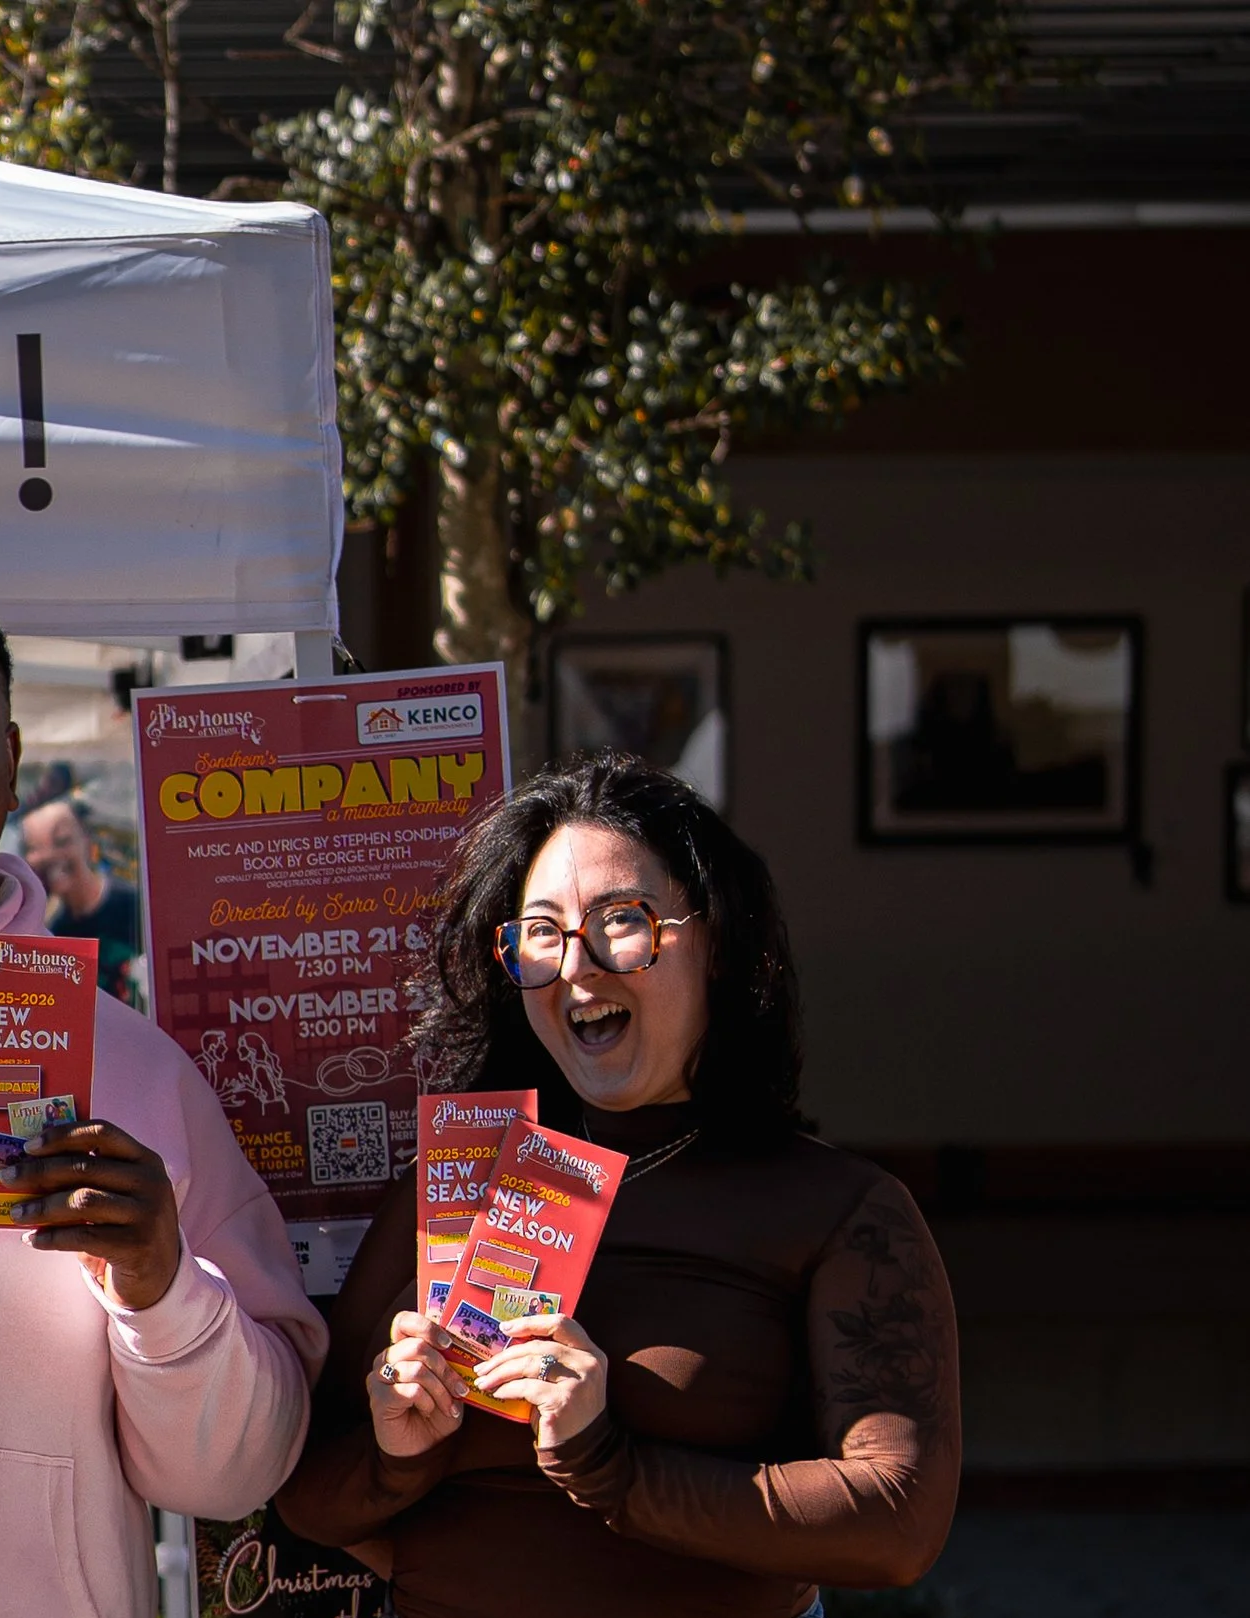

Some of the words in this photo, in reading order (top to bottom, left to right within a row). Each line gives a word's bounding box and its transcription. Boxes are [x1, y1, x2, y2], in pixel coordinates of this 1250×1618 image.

[397, 681, 465, 699] SPONSORED
[468, 680, 482, 690] BY
[156, 703, 177, 716] The
[157, 706, 253, 733] Playhouse
[407, 704, 478, 726] KENCO
[198, 729, 208, 737] of
[209, 725, 238, 736] Wilson
[195, 750, 277, 775] Sondheim's
[159, 751, 486, 822] COMPANY
[327, 808, 340, 823] a
[343, 799, 404, 822] musical
[408, 797, 470, 819] comedy
[188, 843, 231, 860] MUSIC
[235, 841, 265, 856] AND
[268, 837, 310, 854] LYRICS
[314, 836, 330, 850] BY
[332, 832, 392, 849] STEPHEN
[394, 827, 466, 846] SONDHEIM
[243, 856, 284, 872] BOOK
[287, 854, 302, 869] BY
[307, 850, 364, 868] GEORGE
[368, 847, 412, 862] FURTH
[215, 873, 251, 886] ORIGINALLY
[253, 871, 288, 883] PRODUCED
[289, 871, 302, 880] AND
[303, 867, 334, 879] DIRECTED
[336, 866, 346, 875] ON
[347, 863, 381, 875] BROADWAY
[382, 863, 391, 872] BY
[391, 860, 418, 872] HAROLD
[266, 877, 322, 890] ORCHESTRATIONS
[323, 876, 332, 886] BY
[332, 873, 367, 886] JONATHAN
[209, 896, 292, 926] Directed
[294, 896, 318, 924] by
[323, 891, 378, 921] Sara
[191, 928, 361, 966] NOVEMBER
[368, 926, 398, 952] 21
[404, 923, 428, 950] &
[38, 965, 63, 975] Wilson
[294, 958, 338, 979] 7:30
[342, 956, 373, 975] PM
[229, 987, 398, 1025] NOVEMBER
[299, 1020, 341, 1038] 3:00
[347, 1017, 376, 1035] PM
[389, 1110, 410, 1121] BUY
[441, 1100, 457, 1111] The
[442, 1103, 517, 1126] Playhouse
[390, 1120, 417, 1131] TICKE
[480, 1119, 505, 1128] Wilson
[237, 1130, 293, 1147] DVANCE
[532, 1131, 547, 1144] The
[261, 1145, 303, 1160] DOOR
[426, 1146, 499, 1161] 2025-2026
[528, 1134, 603, 1176] Playhouse
[427, 1161, 476, 1182] NEW
[554, 1163, 563, 1172] of
[562, 1164, 589, 1180] Wilson
[492, 1186, 546, 1218] NEW
[499, 1173, 572, 1208] 2025-2026
[485, 1207, 575, 1253] SEASON
[472, 1256, 533, 1284] COMPANY
[225, 1540, 375, 1614] Christmas
